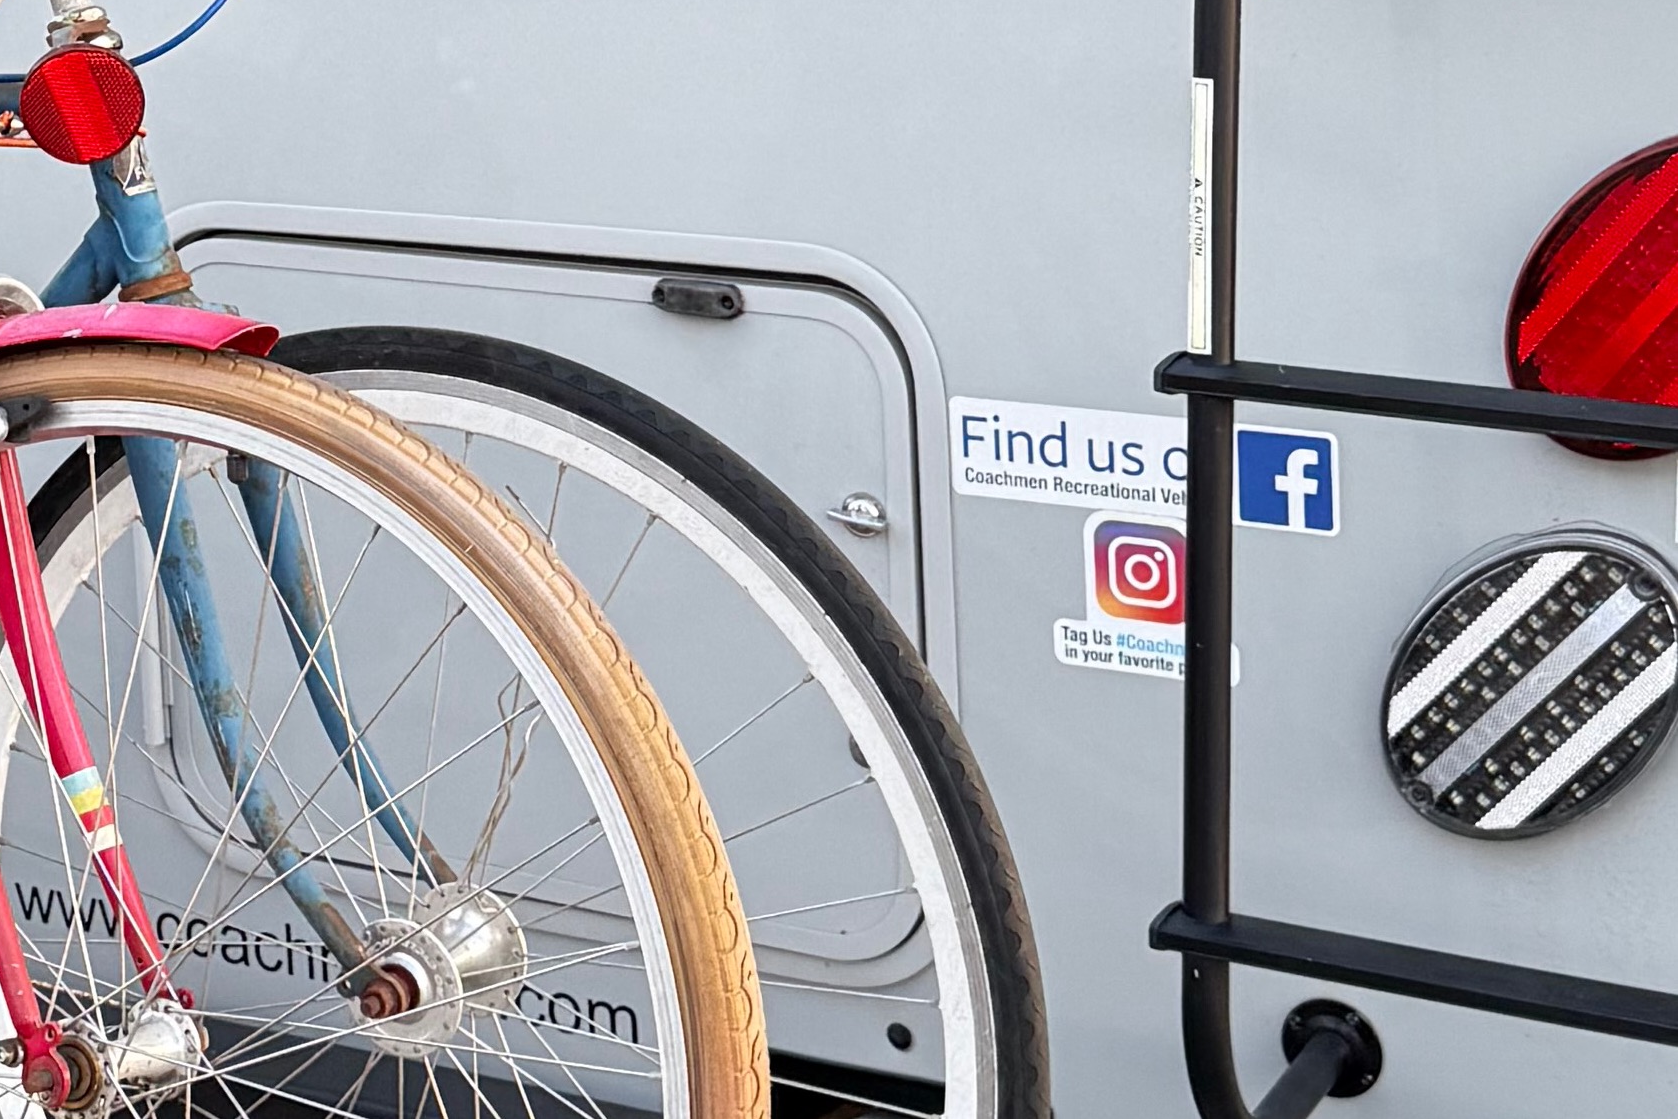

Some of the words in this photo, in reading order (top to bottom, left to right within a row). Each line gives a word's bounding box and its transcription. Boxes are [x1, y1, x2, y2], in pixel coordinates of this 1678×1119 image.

[1194, 195, 1204, 257] CAUTION
[962, 415, 1068, 468] Find
[1088, 438, 1145, 476] us
[1163, 447, 1188, 481] o
[965, 467, 1048, 490] Coachmen
[1053, 477, 1156, 502] Recreational
[1061, 625, 1088, 646] Tag
[1092, 629, 1112, 646] Us
[1064, 643, 1078, 658] in
[1082, 649, 1113, 662] your
[1118, 650, 1174, 672] favorite
